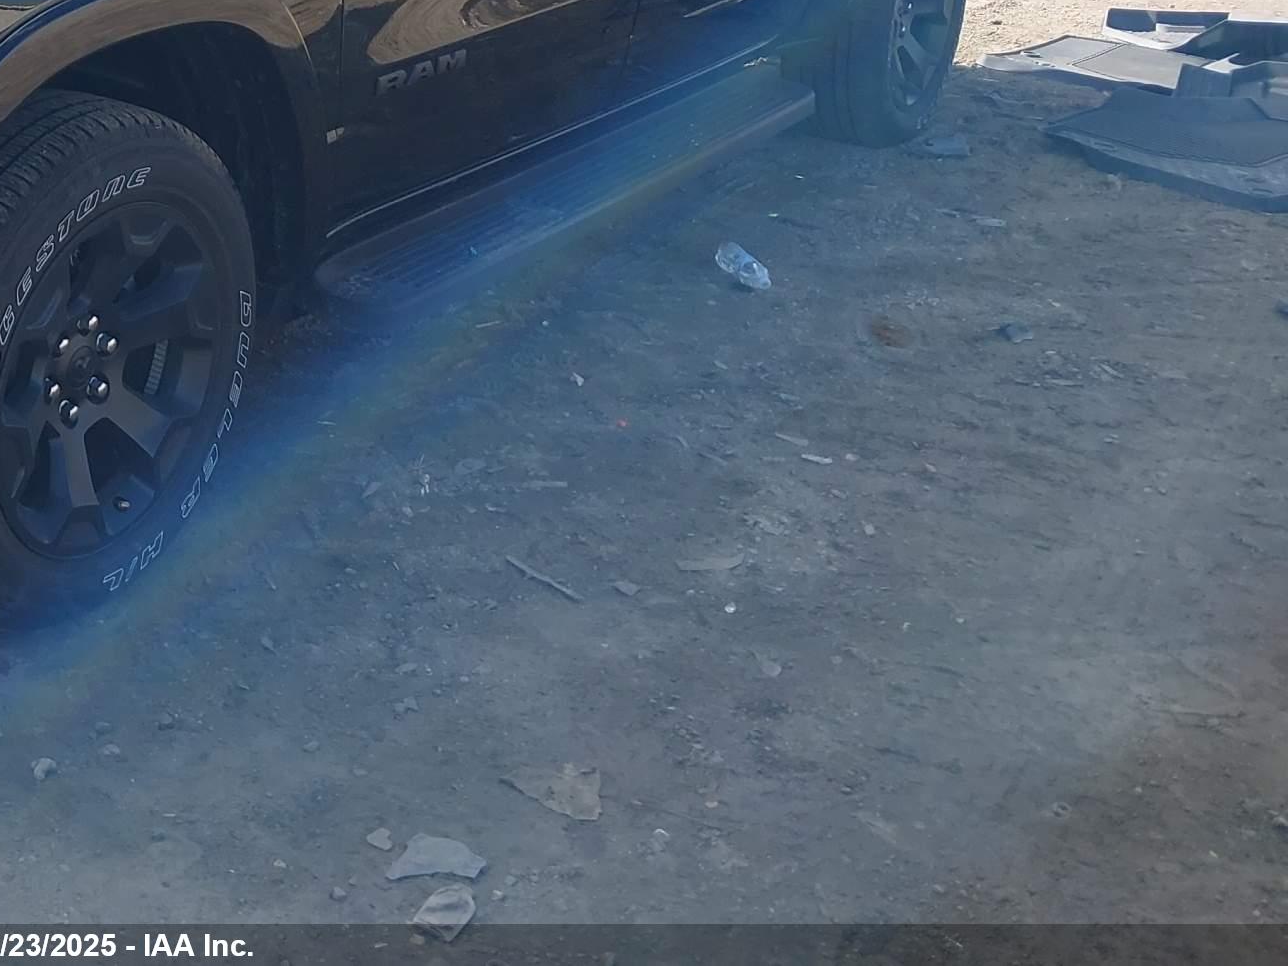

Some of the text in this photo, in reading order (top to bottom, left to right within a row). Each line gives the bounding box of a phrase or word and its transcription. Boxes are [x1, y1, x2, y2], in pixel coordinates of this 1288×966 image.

[374, 48, 468, 97] RAM
[102, 290, 254, 592] DUELER H/L
